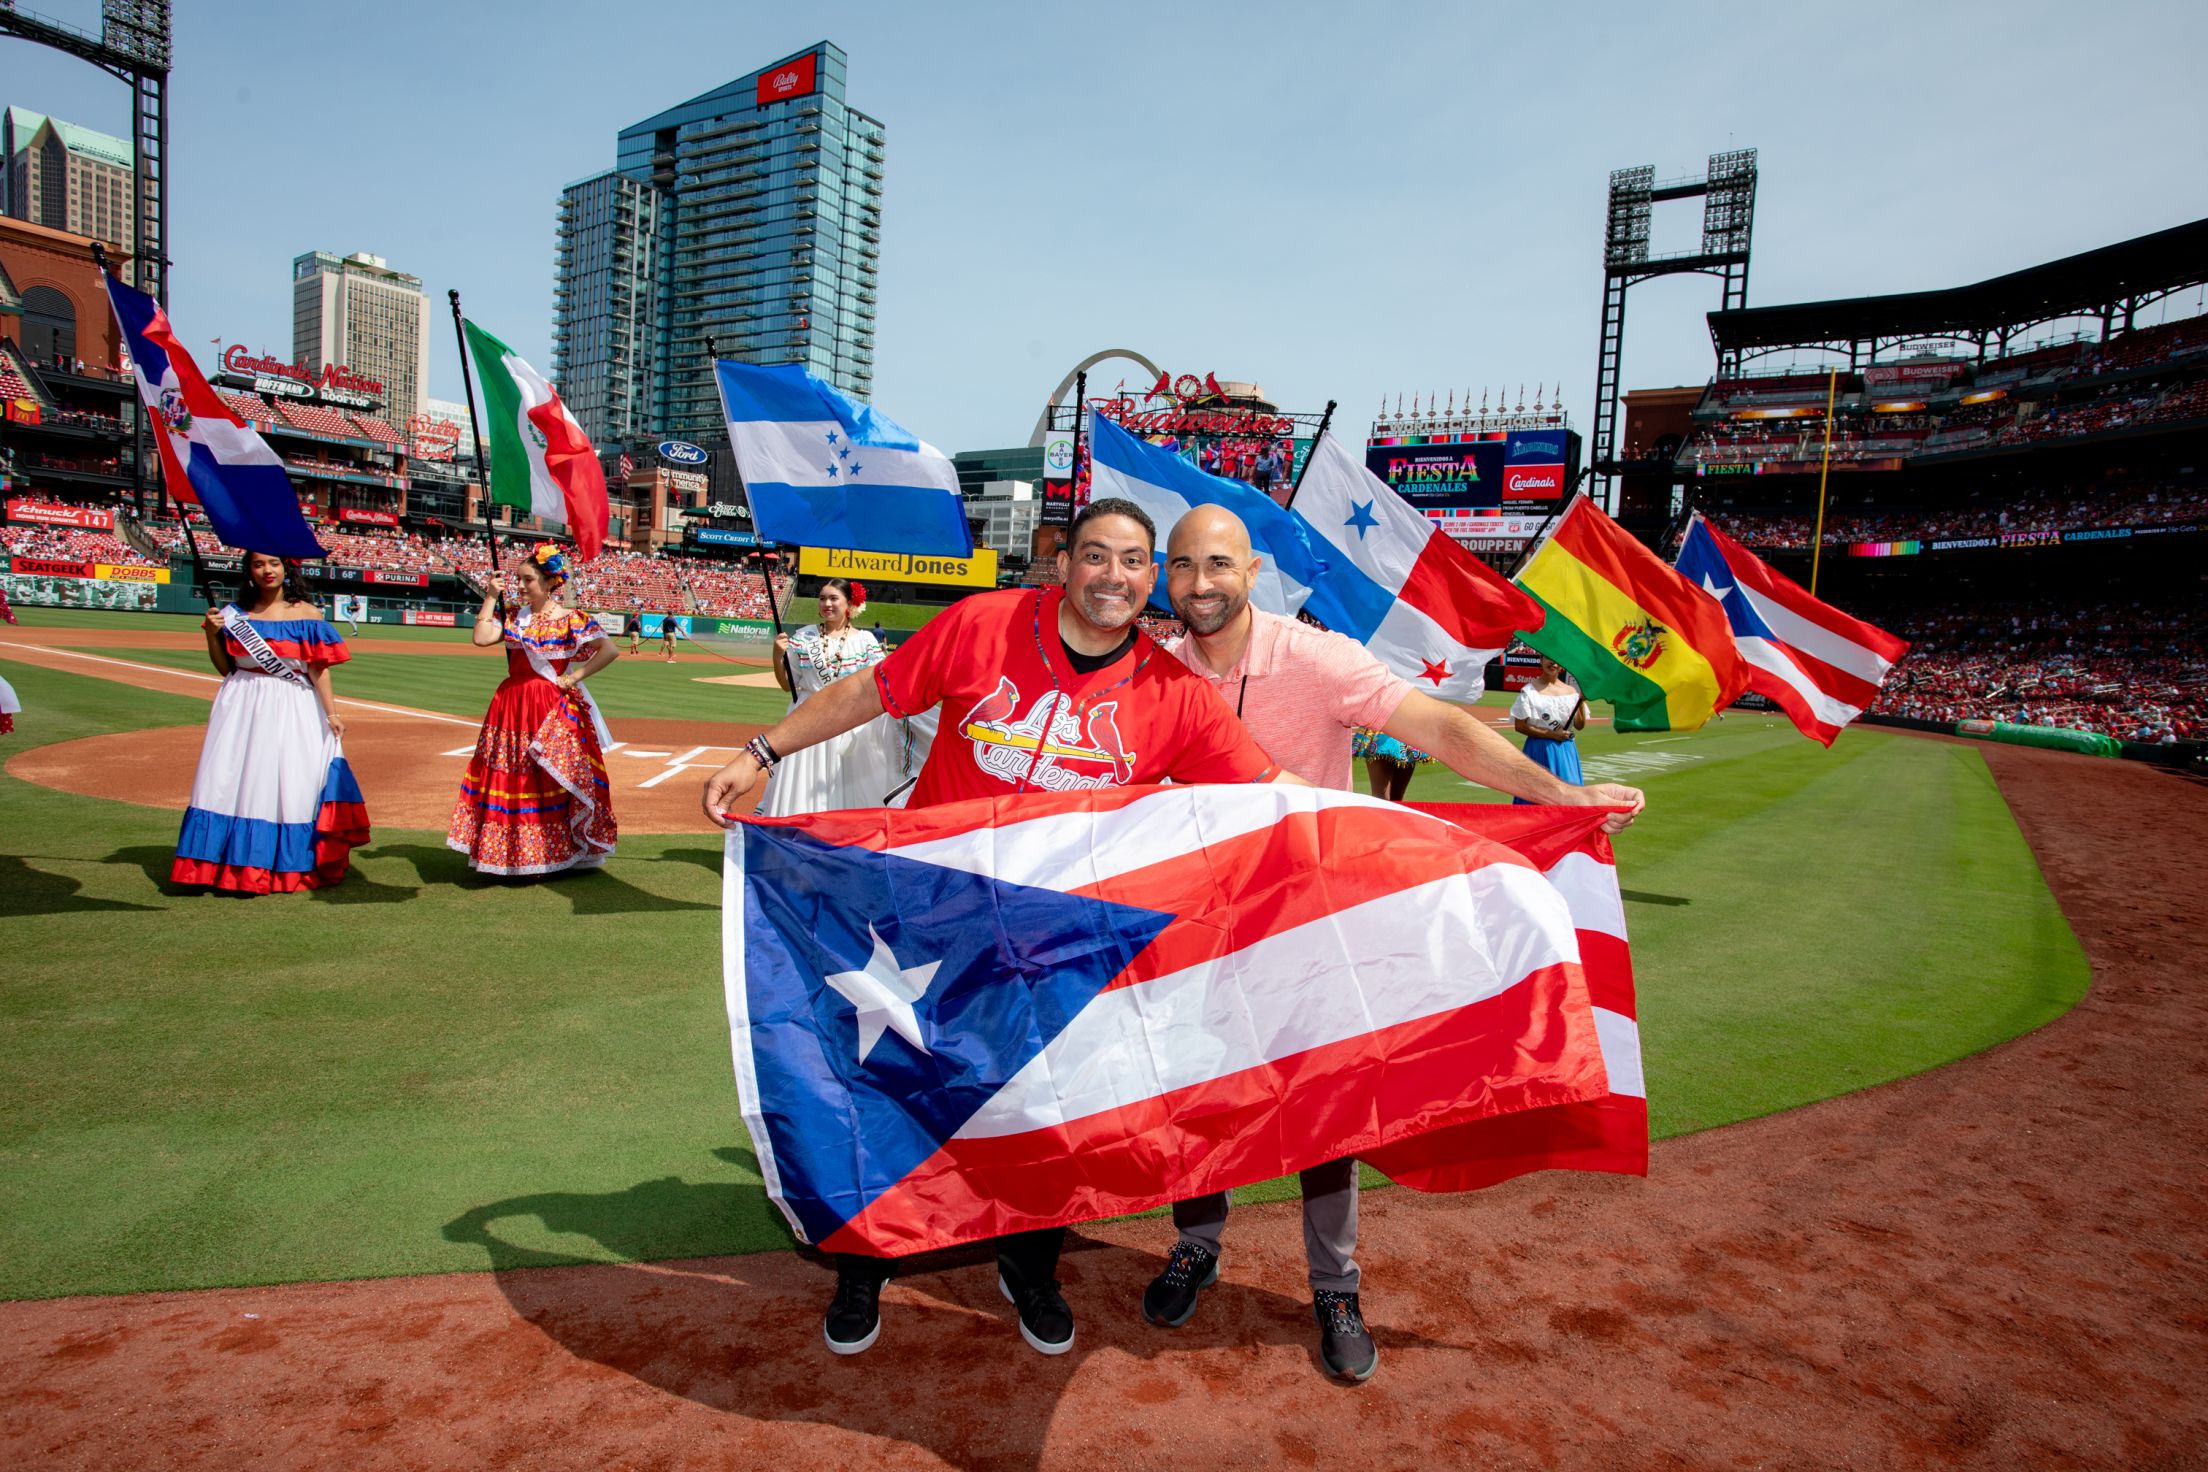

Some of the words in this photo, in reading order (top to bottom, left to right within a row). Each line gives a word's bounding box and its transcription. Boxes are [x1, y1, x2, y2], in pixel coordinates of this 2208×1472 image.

[772, 72, 799, 88] Bally
[1899, 341, 1956, 351] BUDWEISER
[224, 344, 312, 380] Cardinals
[312, 363, 383, 394] Nation
[1903, 365, 1959, 375] BUDWEISER
[255, 378, 304, 394] HOFFMANN
[321, 391, 370, 407] ROOFTOP
[1083, 397, 1294, 434] Budweiser
[405, 414, 462, 444] Bally
[1389, 421, 1444, 433] WORLD
[1451, 415, 1548, 430] CHAMPIONS
[669, 443, 699, 460] Ford
[661, 468, 706, 485] Cmmunity
[1387, 454, 1481, 484] FIESTA
[1707, 463, 1751, 475] FIESTA
[666, 478, 700, 489] merica
[1397, 482, 1468, 494] CARDENALES
[1509, 474, 1555, 491] Cardinals
[13, 504, 82, 518] Schnucks
[1524, 522, 1534, 531] GO
[700, 531, 723, 540] SCOTT
[723, 533, 750, 543] CREDIT
[1460, 539, 1523, 551] ROUPPEN
[1932, 539, 1990, 550] BIENVENIDOS
[1990, 538, 1997, 546] A
[1999, 531, 2062, 548] FIESTA
[2064, 528, 2132, 541] CARDENALES
[19, 560, 87, 576] SEATGEEK
[208, 561, 229, 569] Mercy
[827, 548, 903, 573] Edward
[904, 554, 968, 576] Jones
[111, 567, 157, 578] DOBBS
[385, 574, 417, 583] PURINA
[729, 623, 770, 635] National
[230, 620, 285, 674] DOMINICAN
[809, 640, 831, 684] HONDUR
[1507, 656, 1541, 664] BIENVENIDO
[1012, 689, 1083, 751] Los
[972, 721, 1121, 791] Cardenal
